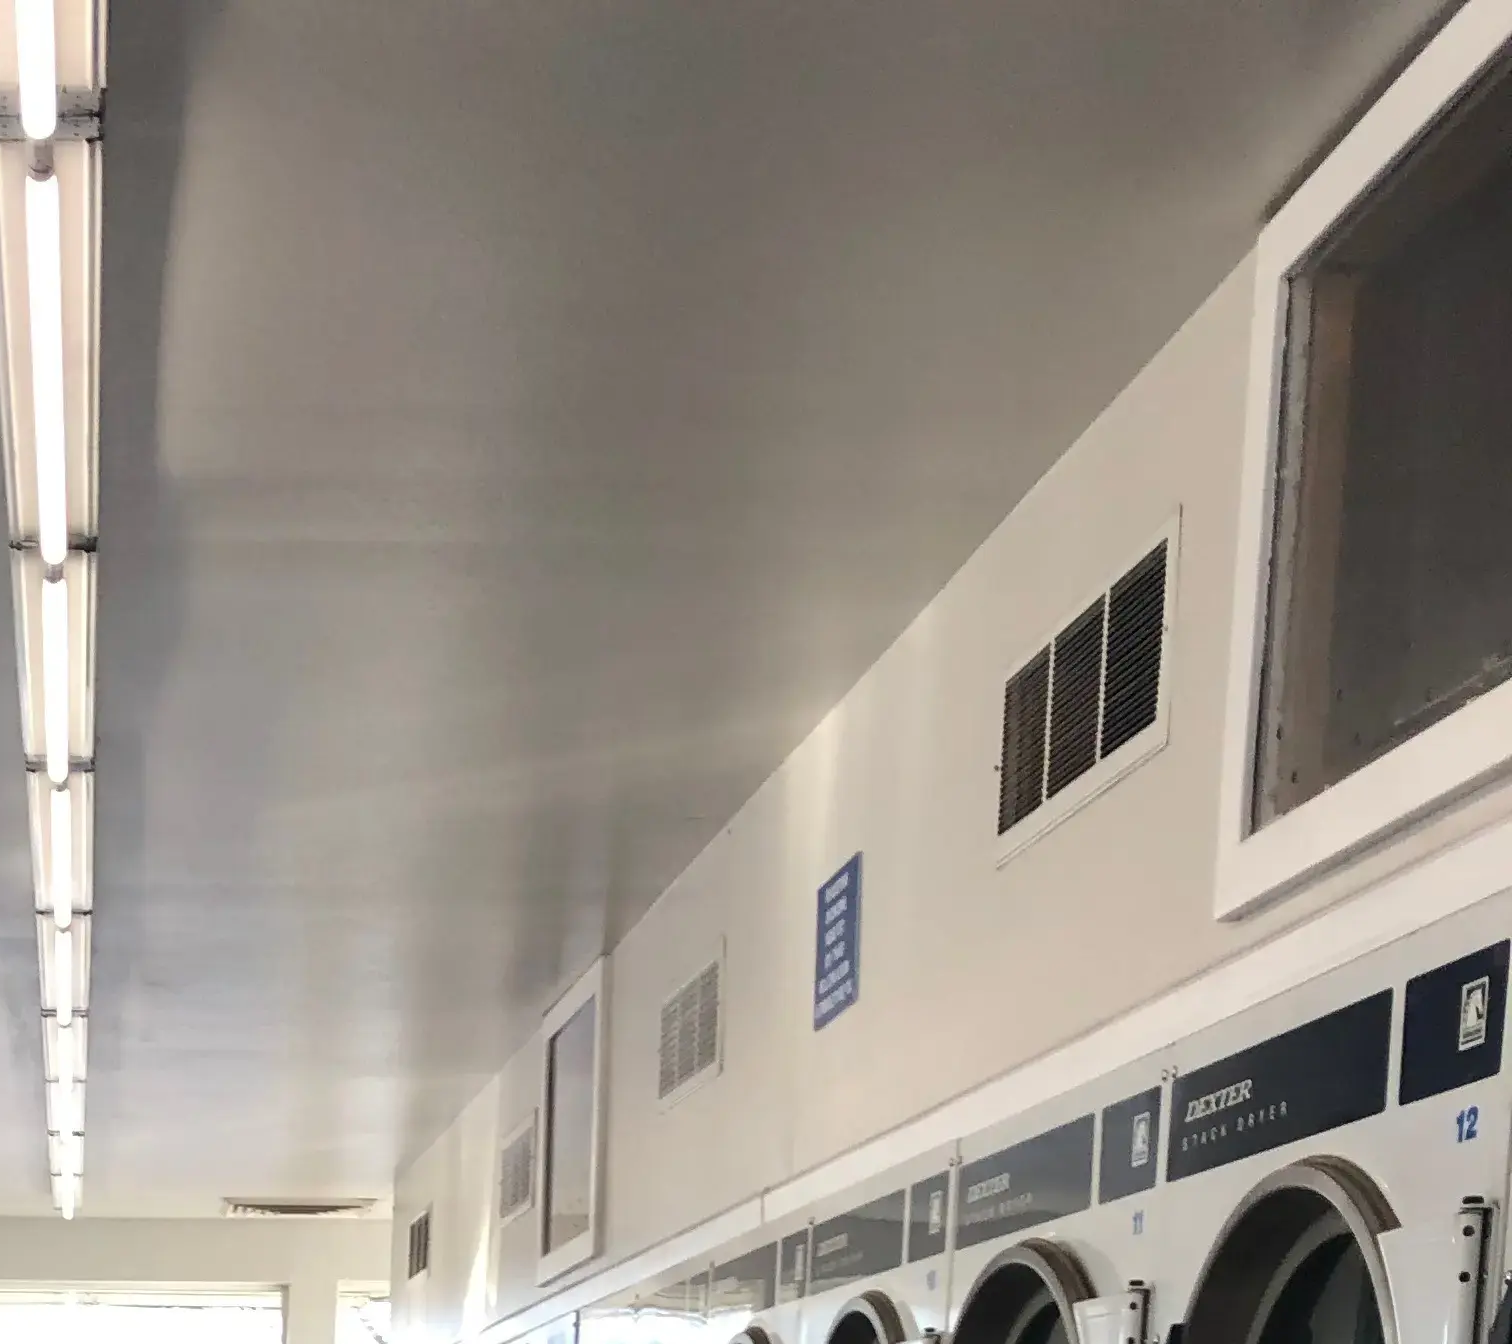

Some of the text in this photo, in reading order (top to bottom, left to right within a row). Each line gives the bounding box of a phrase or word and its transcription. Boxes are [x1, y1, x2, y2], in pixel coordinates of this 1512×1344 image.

[1185, 1079, 1252, 1122] DEXTER
[1236, 1100, 1287, 1132] DRYER
[1456, 1105, 1479, 1143] 12
